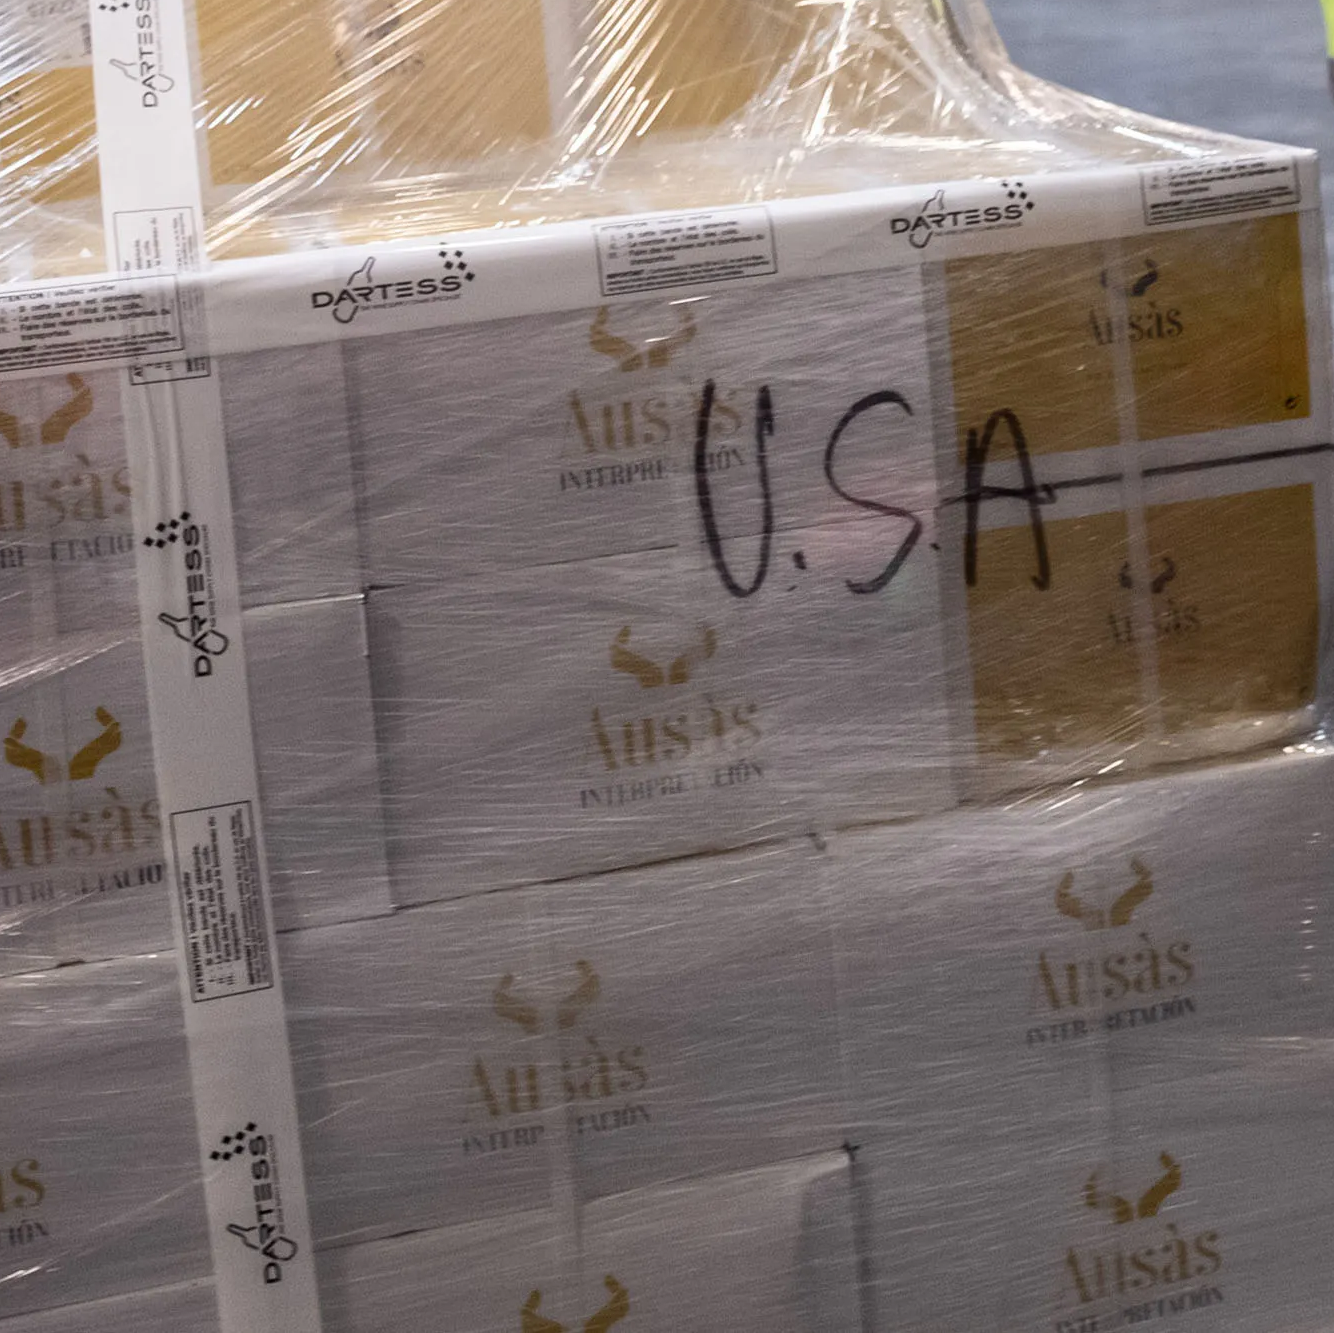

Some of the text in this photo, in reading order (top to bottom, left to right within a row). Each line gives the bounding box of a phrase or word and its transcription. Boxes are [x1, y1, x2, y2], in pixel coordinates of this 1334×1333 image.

[890, 204, 1023, 235] DARTESS
[311, 275, 462, 309] DARTESS
[183, 524, 213, 678] DARTESS
[249, 1135, 282, 1285] DARTESS
